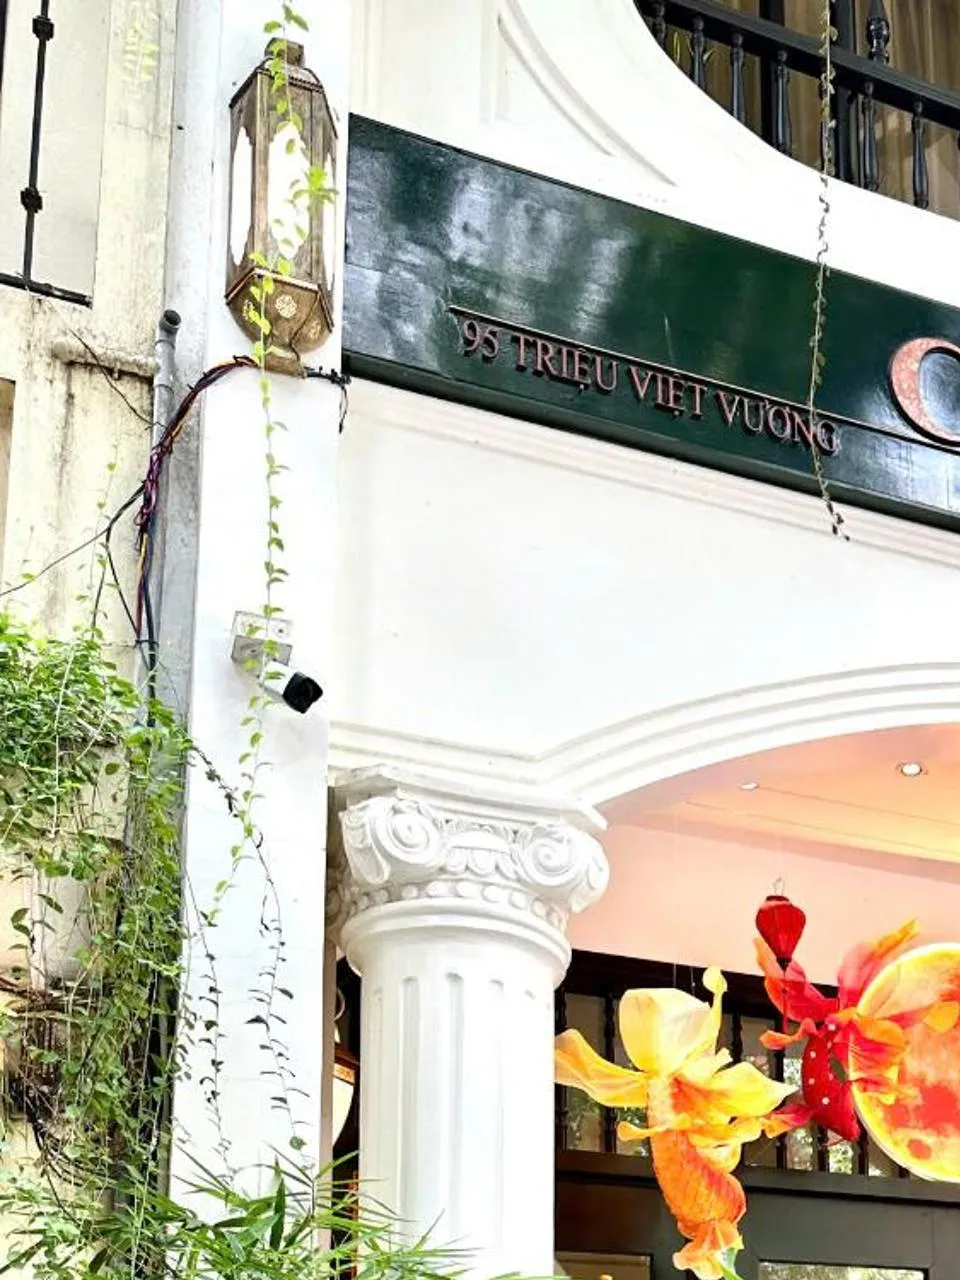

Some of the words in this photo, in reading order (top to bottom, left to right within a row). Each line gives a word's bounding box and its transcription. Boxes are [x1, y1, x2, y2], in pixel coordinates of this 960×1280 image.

[463, 319, 501, 358] 95
[510, 329, 620, 392] TRIỆU
[629, 365, 708, 417] VIỆT
